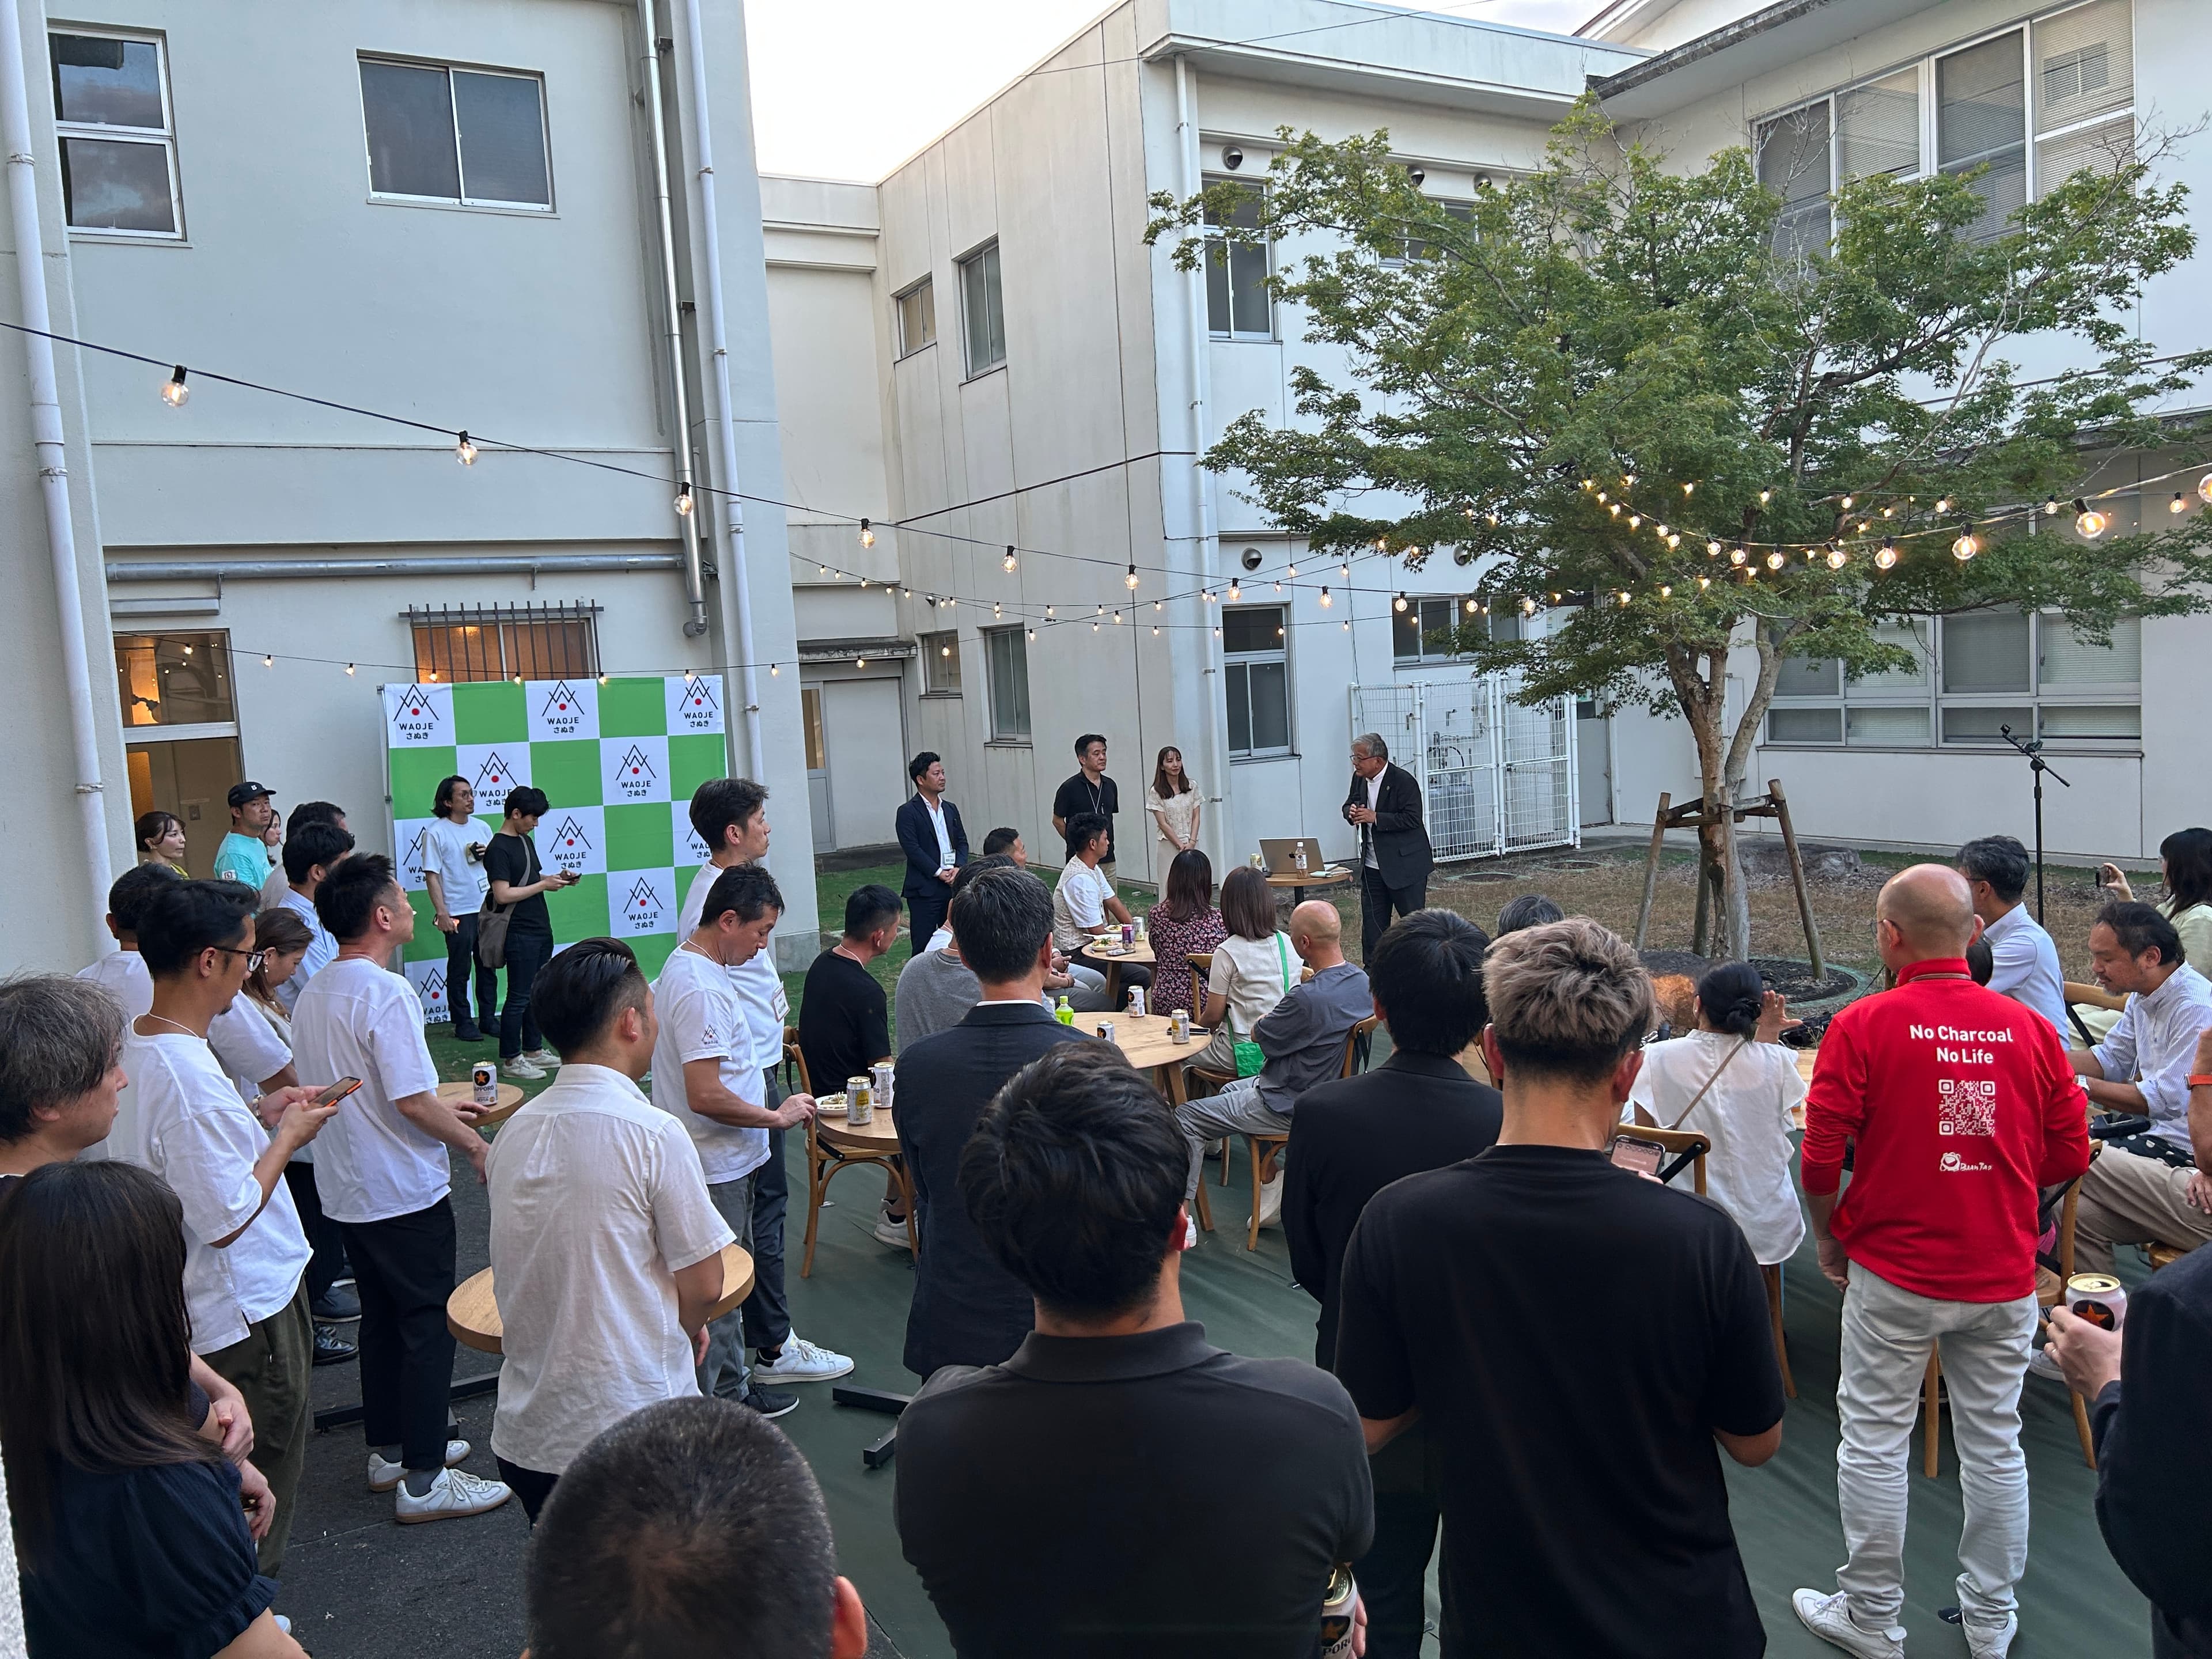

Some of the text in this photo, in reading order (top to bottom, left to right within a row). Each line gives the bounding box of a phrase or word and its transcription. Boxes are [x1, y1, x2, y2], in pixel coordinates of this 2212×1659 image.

[684, 711, 714, 719] WAOJE
[547, 717, 579, 725] WAOJE
[399, 722, 434, 730] WAOJE
[554, 726, 575, 734] さぬき
[621, 780, 652, 789] WAOJE
[555, 852, 586, 861] WAOJE
[560, 861, 582, 869] さぬき
[628, 911, 658, 921] WAOJE
[635, 921, 654, 929] さぬき
[1909, 1024, 2014, 1042] No Charcoal
[1936, 1047, 1994, 1064] No Life
